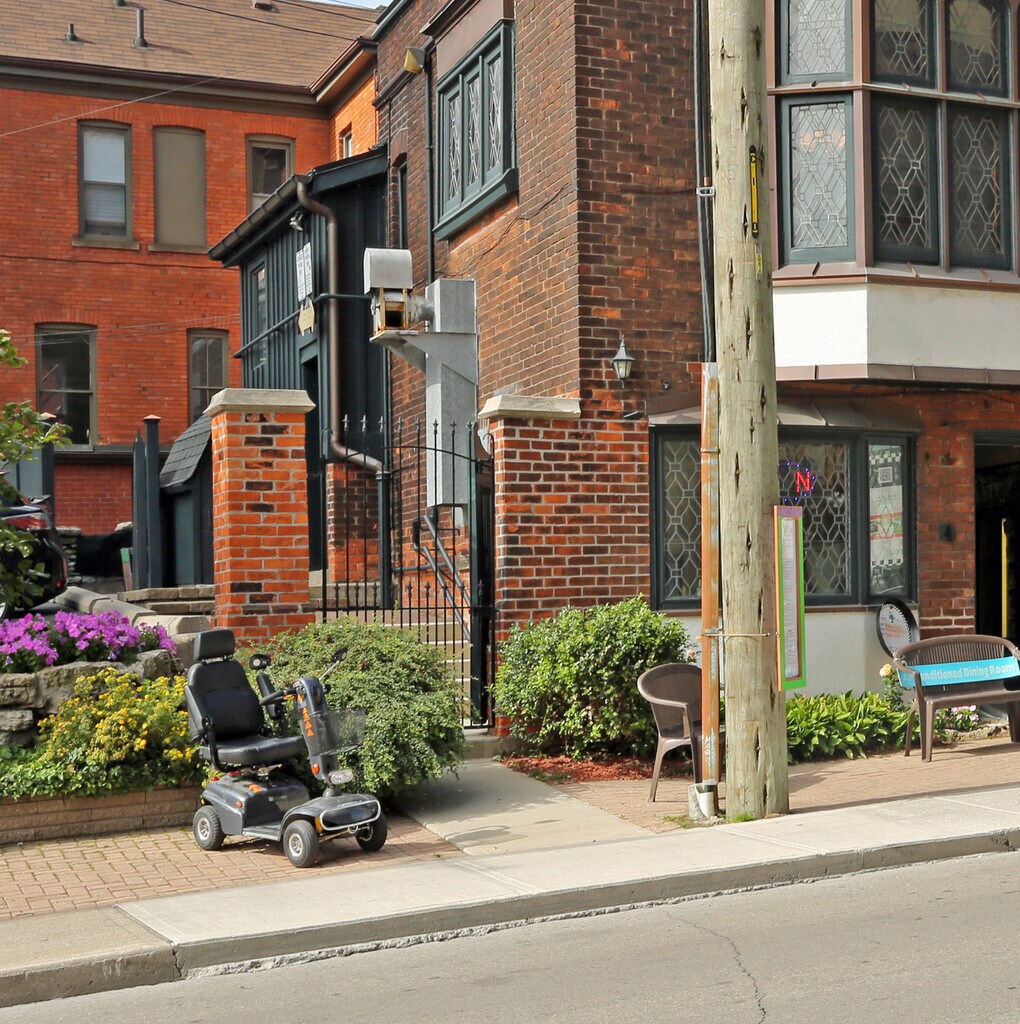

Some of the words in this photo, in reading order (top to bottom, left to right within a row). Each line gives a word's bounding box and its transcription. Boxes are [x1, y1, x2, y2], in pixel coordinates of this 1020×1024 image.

[920, 666, 962, 680] onditioned
[963, 666, 989, 678] Dining
[988, 663, 1015, 675] Room
